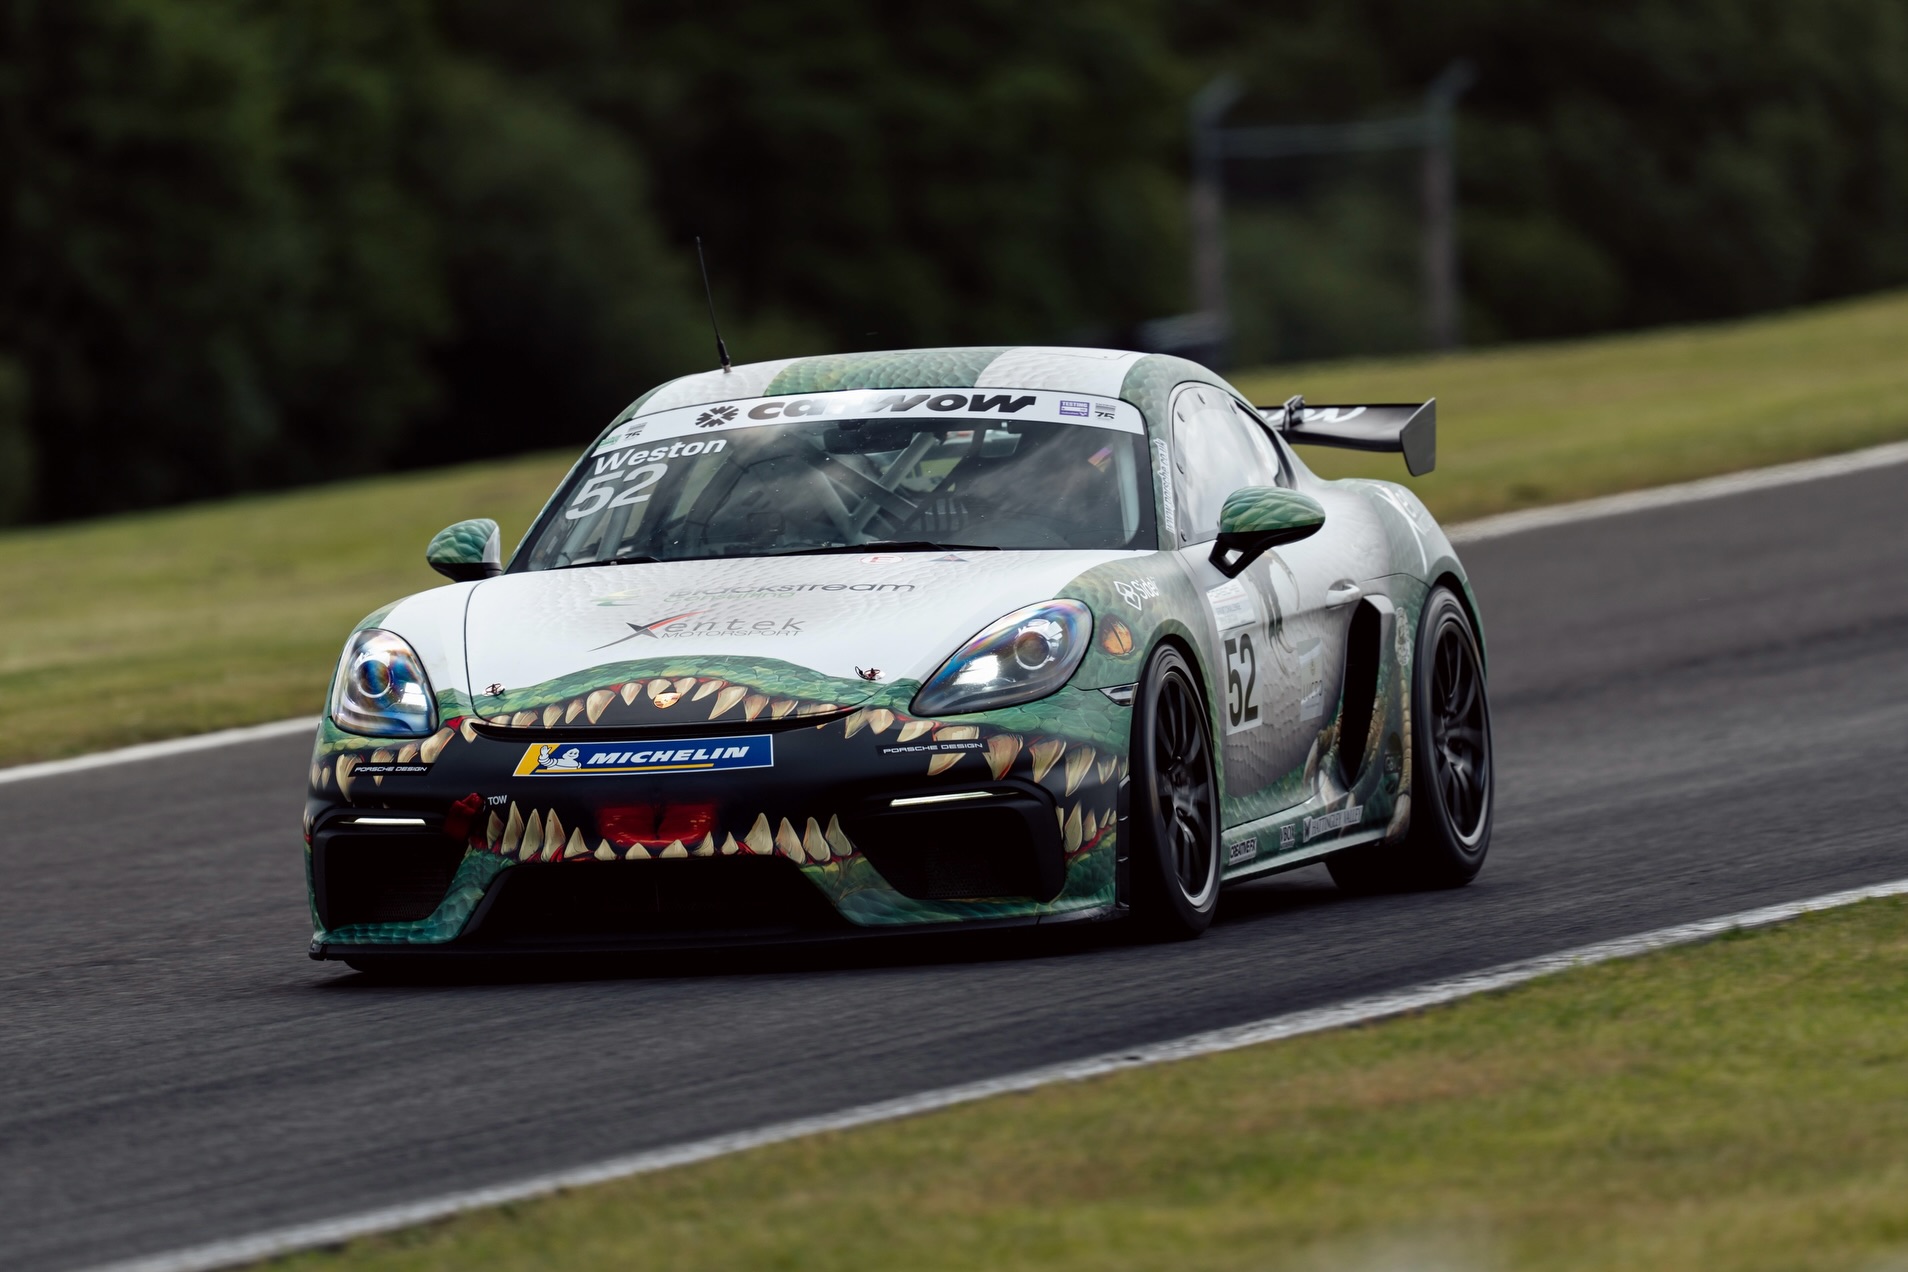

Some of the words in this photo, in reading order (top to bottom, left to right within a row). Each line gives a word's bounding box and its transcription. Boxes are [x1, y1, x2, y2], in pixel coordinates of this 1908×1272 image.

[748, 393, 1036, 421] cawow
[594, 439, 727, 476] Weston
[565, 463, 668, 520] 52
[661, 630, 804, 639] MOTORSPORT
[1224, 633, 1259, 728] 52
[586, 746, 750, 765] MICHELIN
[883, 744, 938, 754] PORSCHE
[940, 742, 983, 750] DESIGN
[487, 795, 508, 806] TOW
